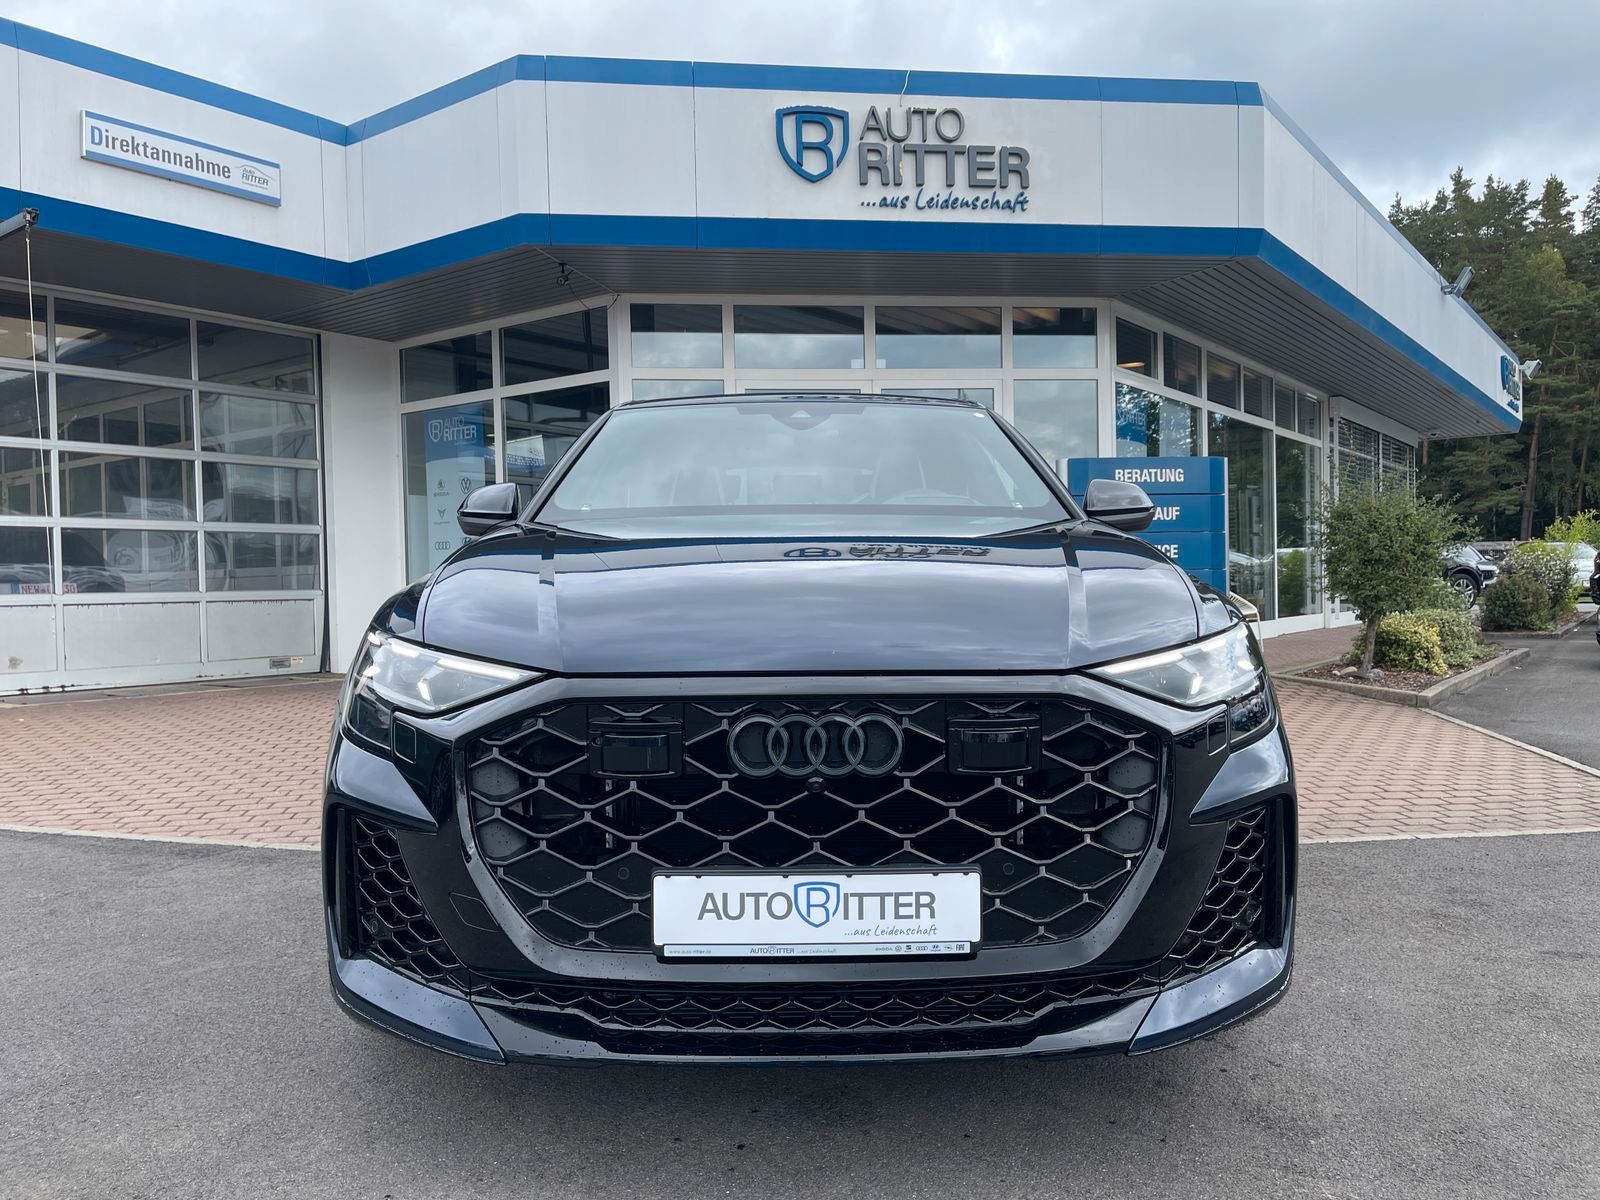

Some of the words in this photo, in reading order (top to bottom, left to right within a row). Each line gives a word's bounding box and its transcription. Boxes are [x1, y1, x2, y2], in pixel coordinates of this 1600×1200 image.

[859, 105, 965, 143] AUTO
[90, 125, 231, 179] Direktannahme
[858, 142, 1030, 189] RITTER
[241, 172, 269, 187] RITTER
[915, 188, 1030, 213] Leidenschaft
[444, 416, 465, 428] AUTO
[443, 425, 477, 441] RITTER
[1115, 468, 1185, 483] BERATUNG
[1152, 507, 1180, 520] AUF
[874, 923, 938, 938] Leidenschaft
